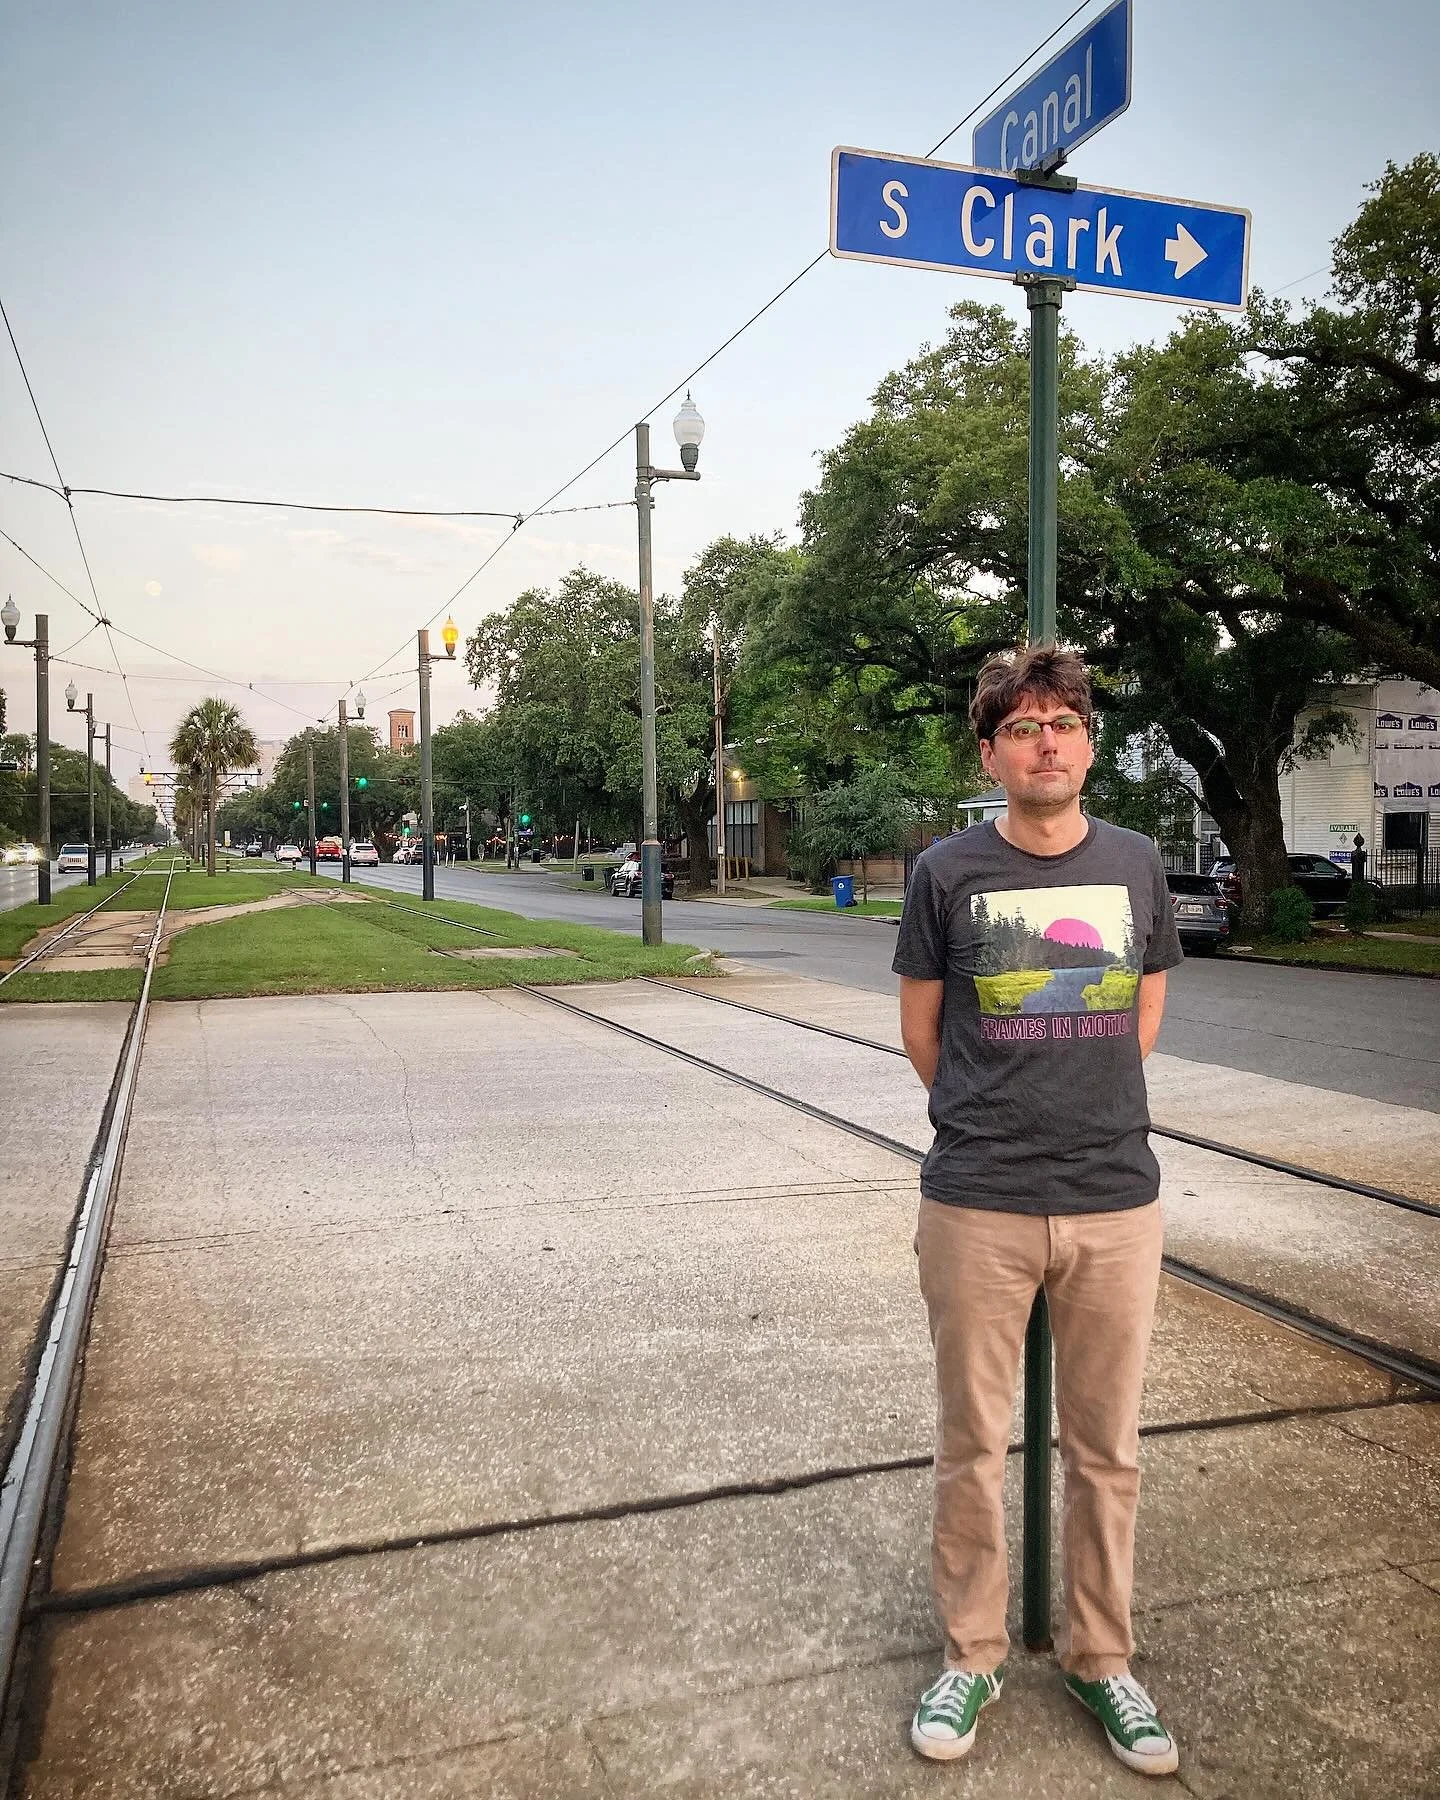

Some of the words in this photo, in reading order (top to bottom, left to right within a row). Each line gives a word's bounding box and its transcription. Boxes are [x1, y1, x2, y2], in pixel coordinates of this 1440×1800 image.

[1001, 42, 1093, 171] Canal
[879, 181, 909, 239] S
[961, 186, 1124, 277] Clark
[981, 1017, 1047, 1040] FRAMES
[1052, 1016, 1072, 1039] IN
